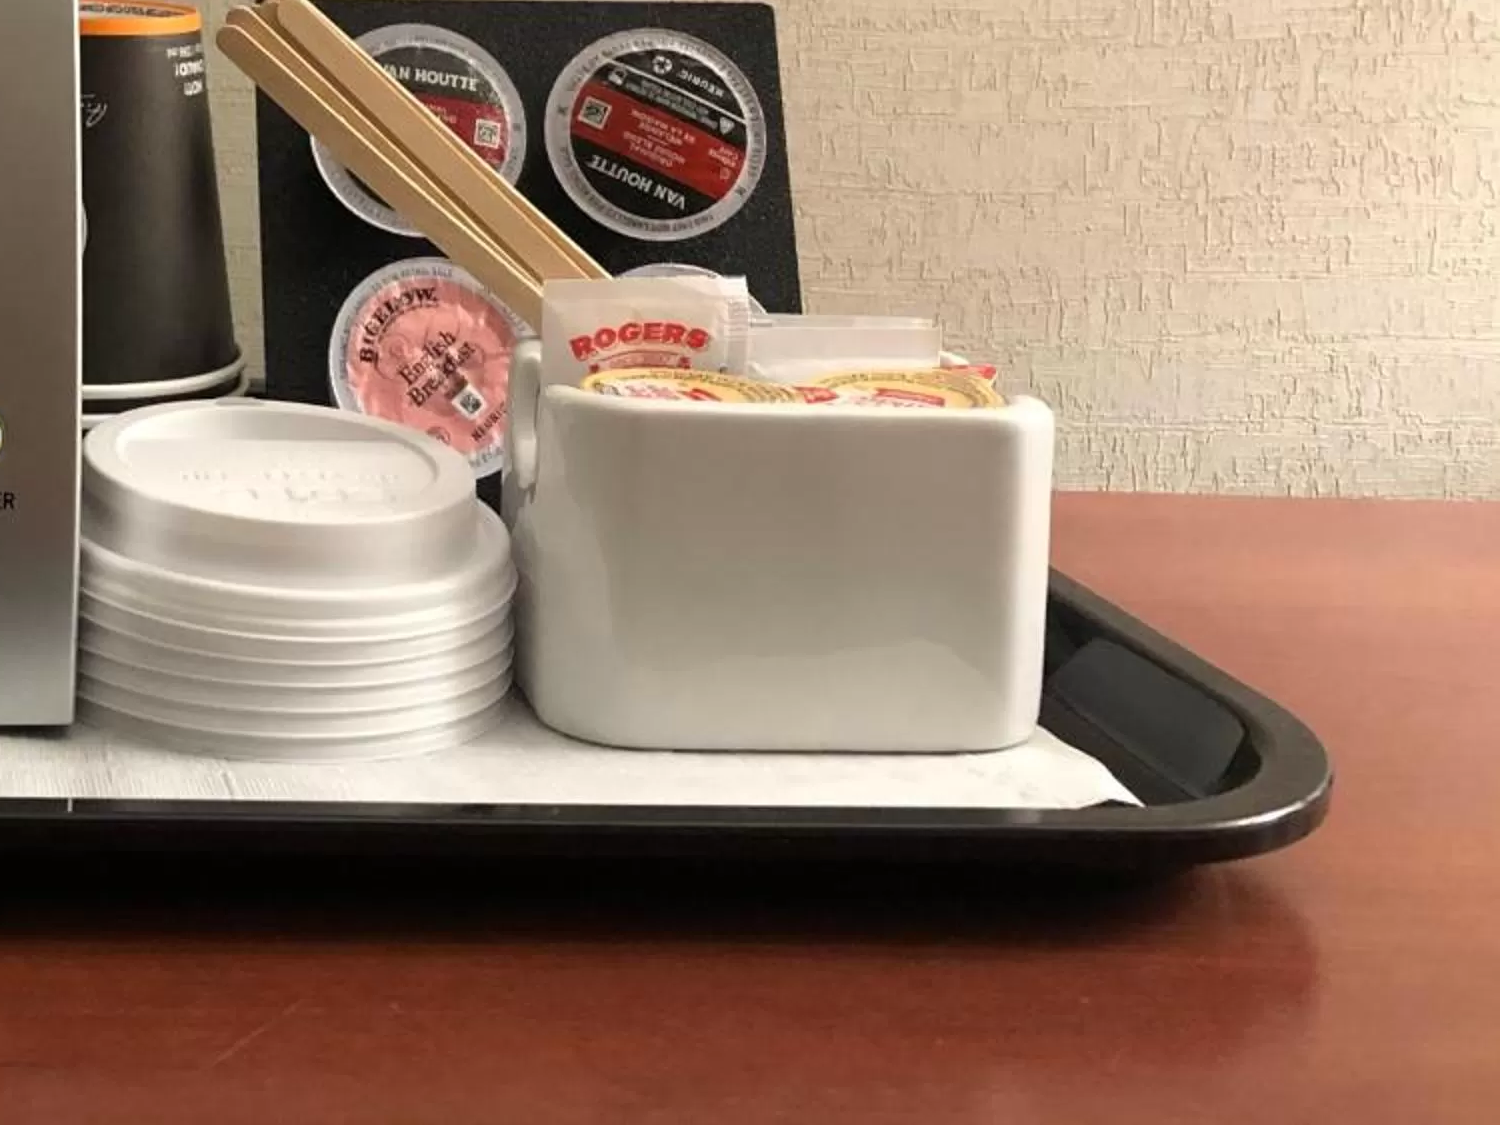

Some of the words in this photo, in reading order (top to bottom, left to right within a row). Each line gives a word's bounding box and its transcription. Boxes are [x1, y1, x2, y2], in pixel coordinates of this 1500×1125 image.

[382, 64, 410, 80] VAN
[414, 68, 479, 92] HOUTTE
[586, 153, 653, 192] HOUTTE
[651, 183, 687, 211] VAN
[569, 322, 710, 361] ROGERS
